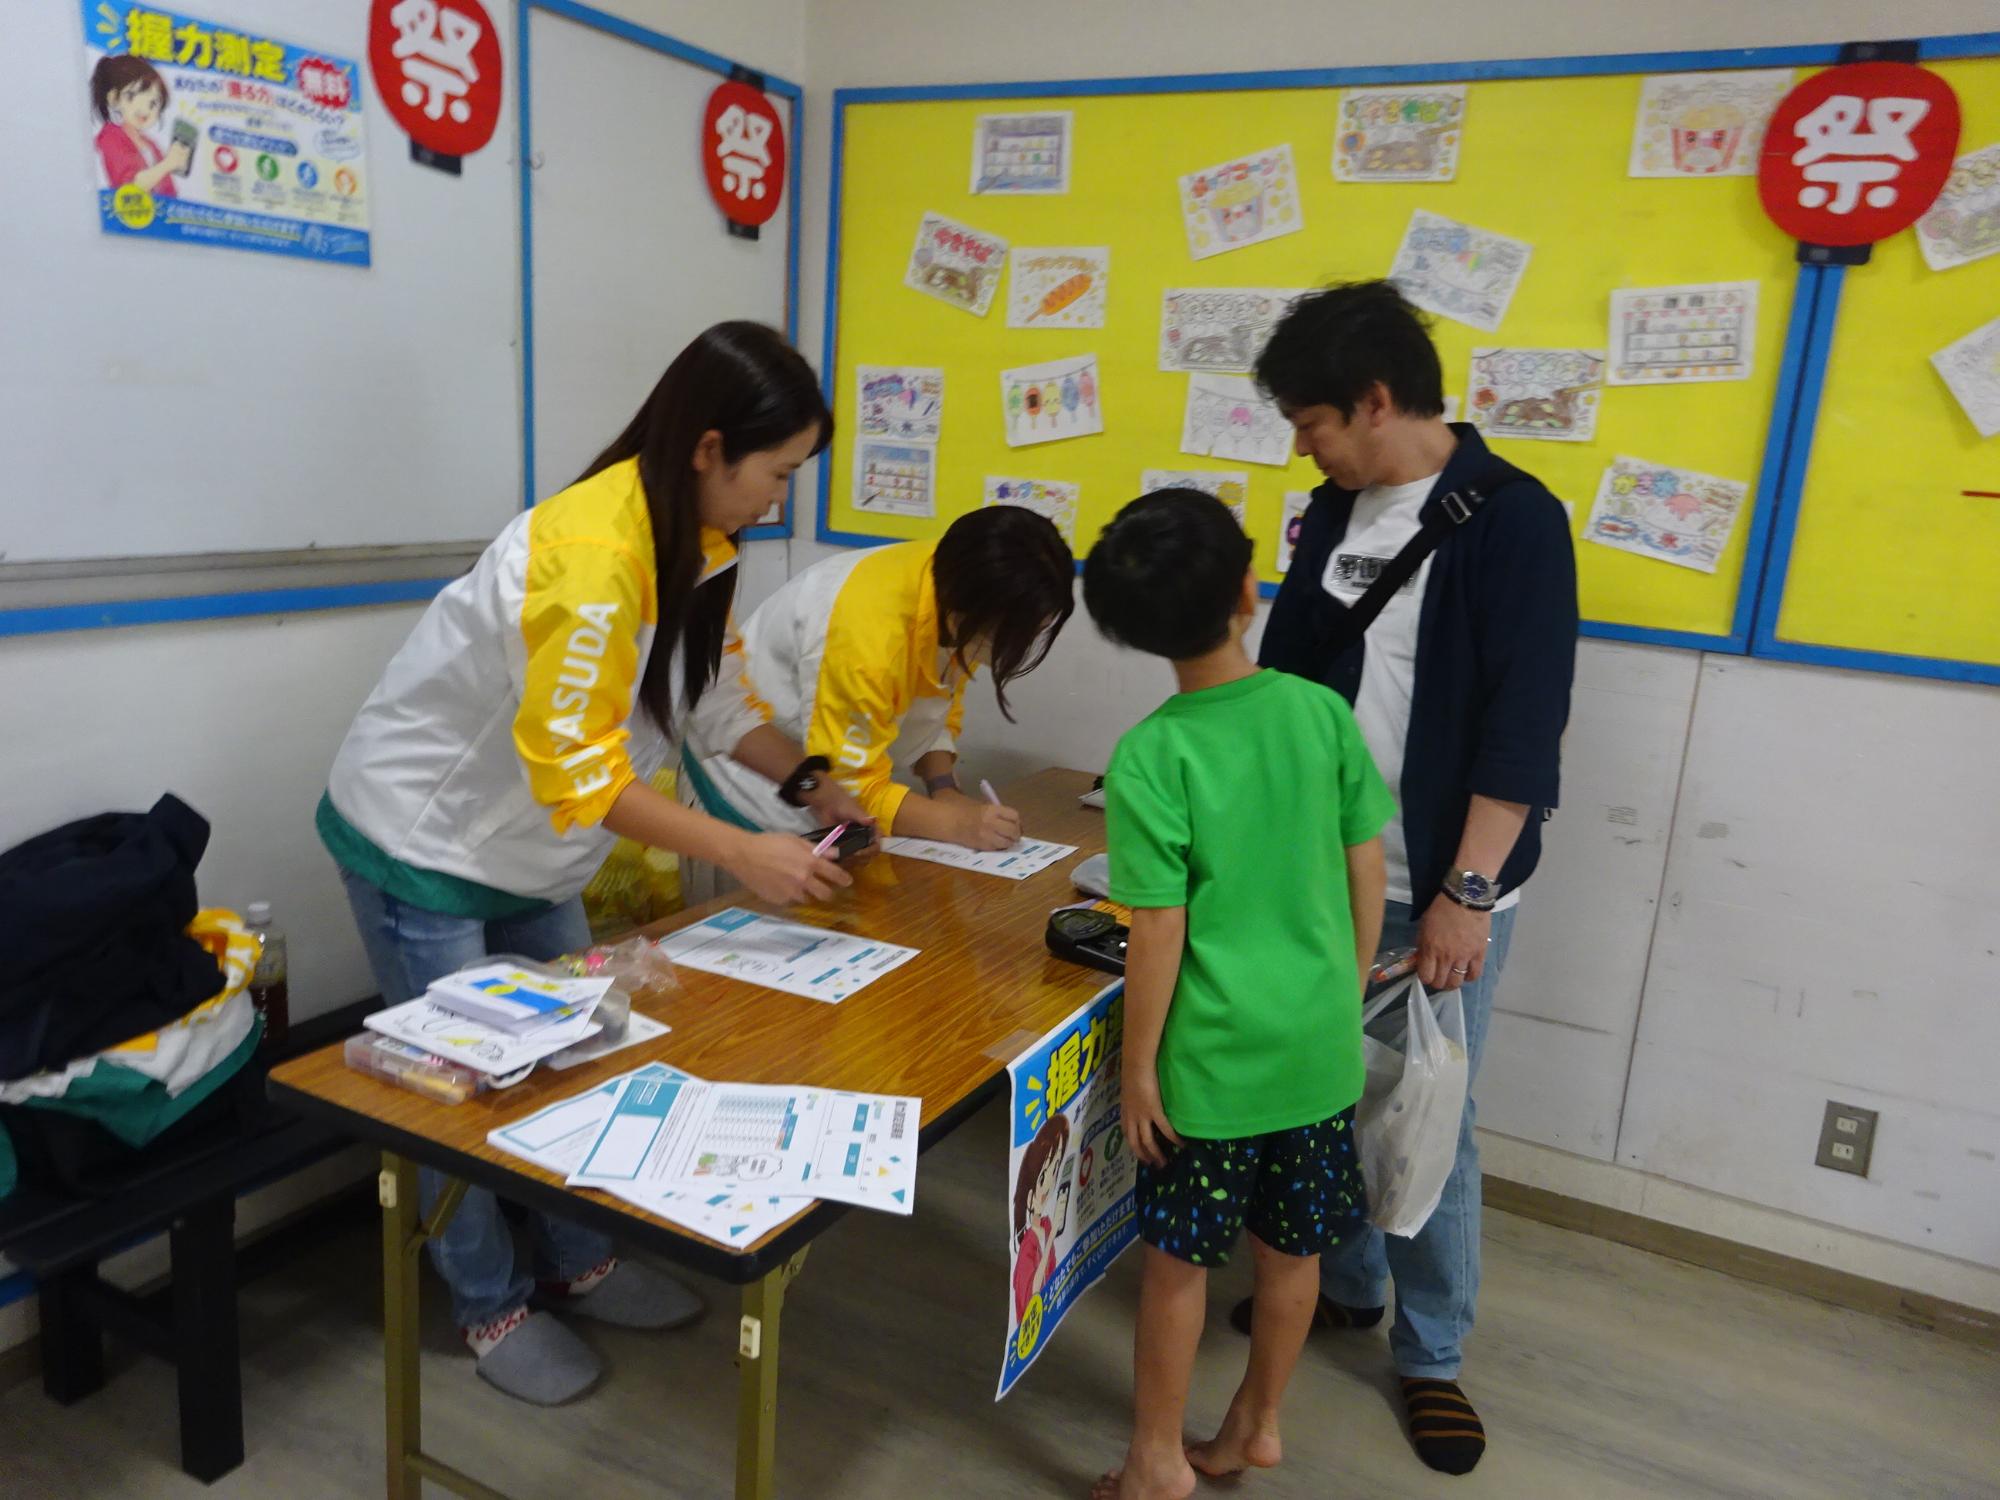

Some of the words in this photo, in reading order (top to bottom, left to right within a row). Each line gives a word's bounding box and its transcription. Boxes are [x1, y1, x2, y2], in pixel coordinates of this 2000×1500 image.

[126, 8, 287, 82] 握力測定
[390, 0, 482, 123] 祭
[716, 104, 772, 200] 祭
[1792, 95, 1932, 214] 祭
